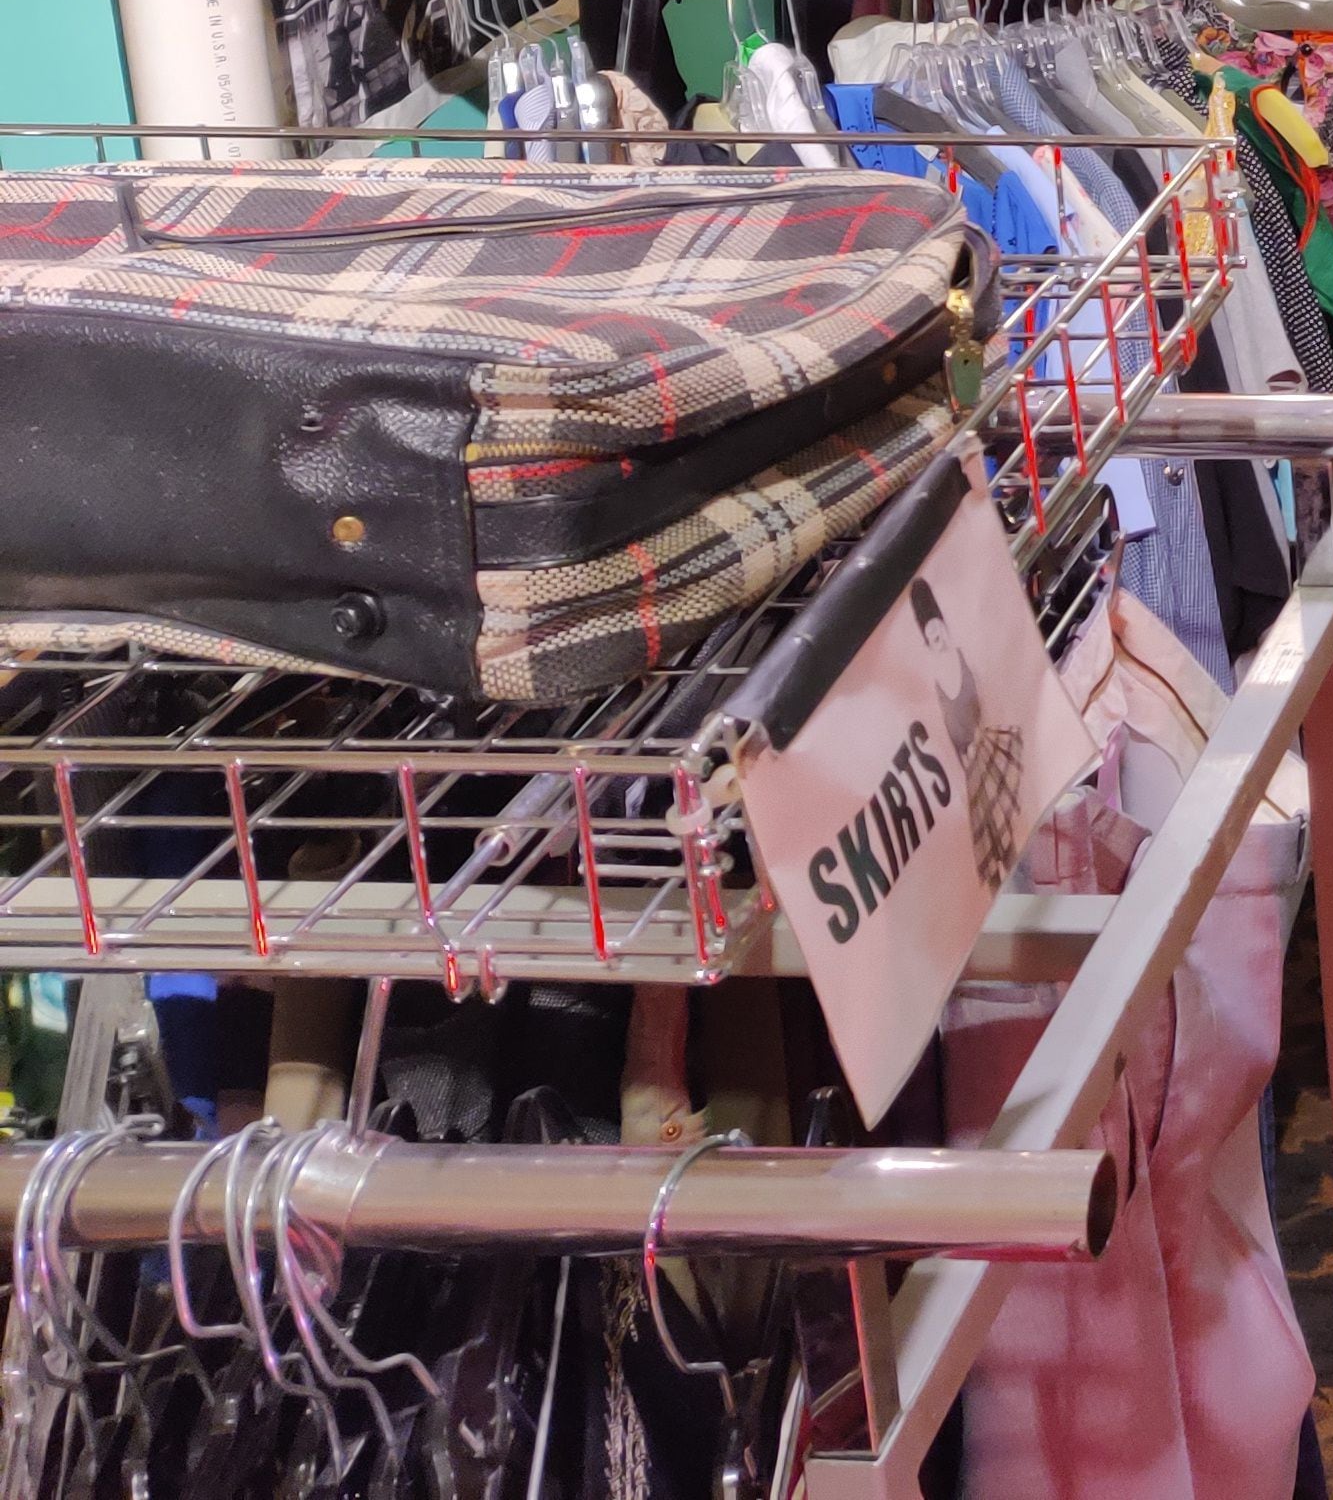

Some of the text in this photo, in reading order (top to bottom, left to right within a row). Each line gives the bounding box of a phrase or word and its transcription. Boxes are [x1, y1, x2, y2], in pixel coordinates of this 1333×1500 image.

[208, 15, 223, 27] IN
[210, 31, 227, 69] U.S.A.
[808, 721, 953, 946] SKIRTS
